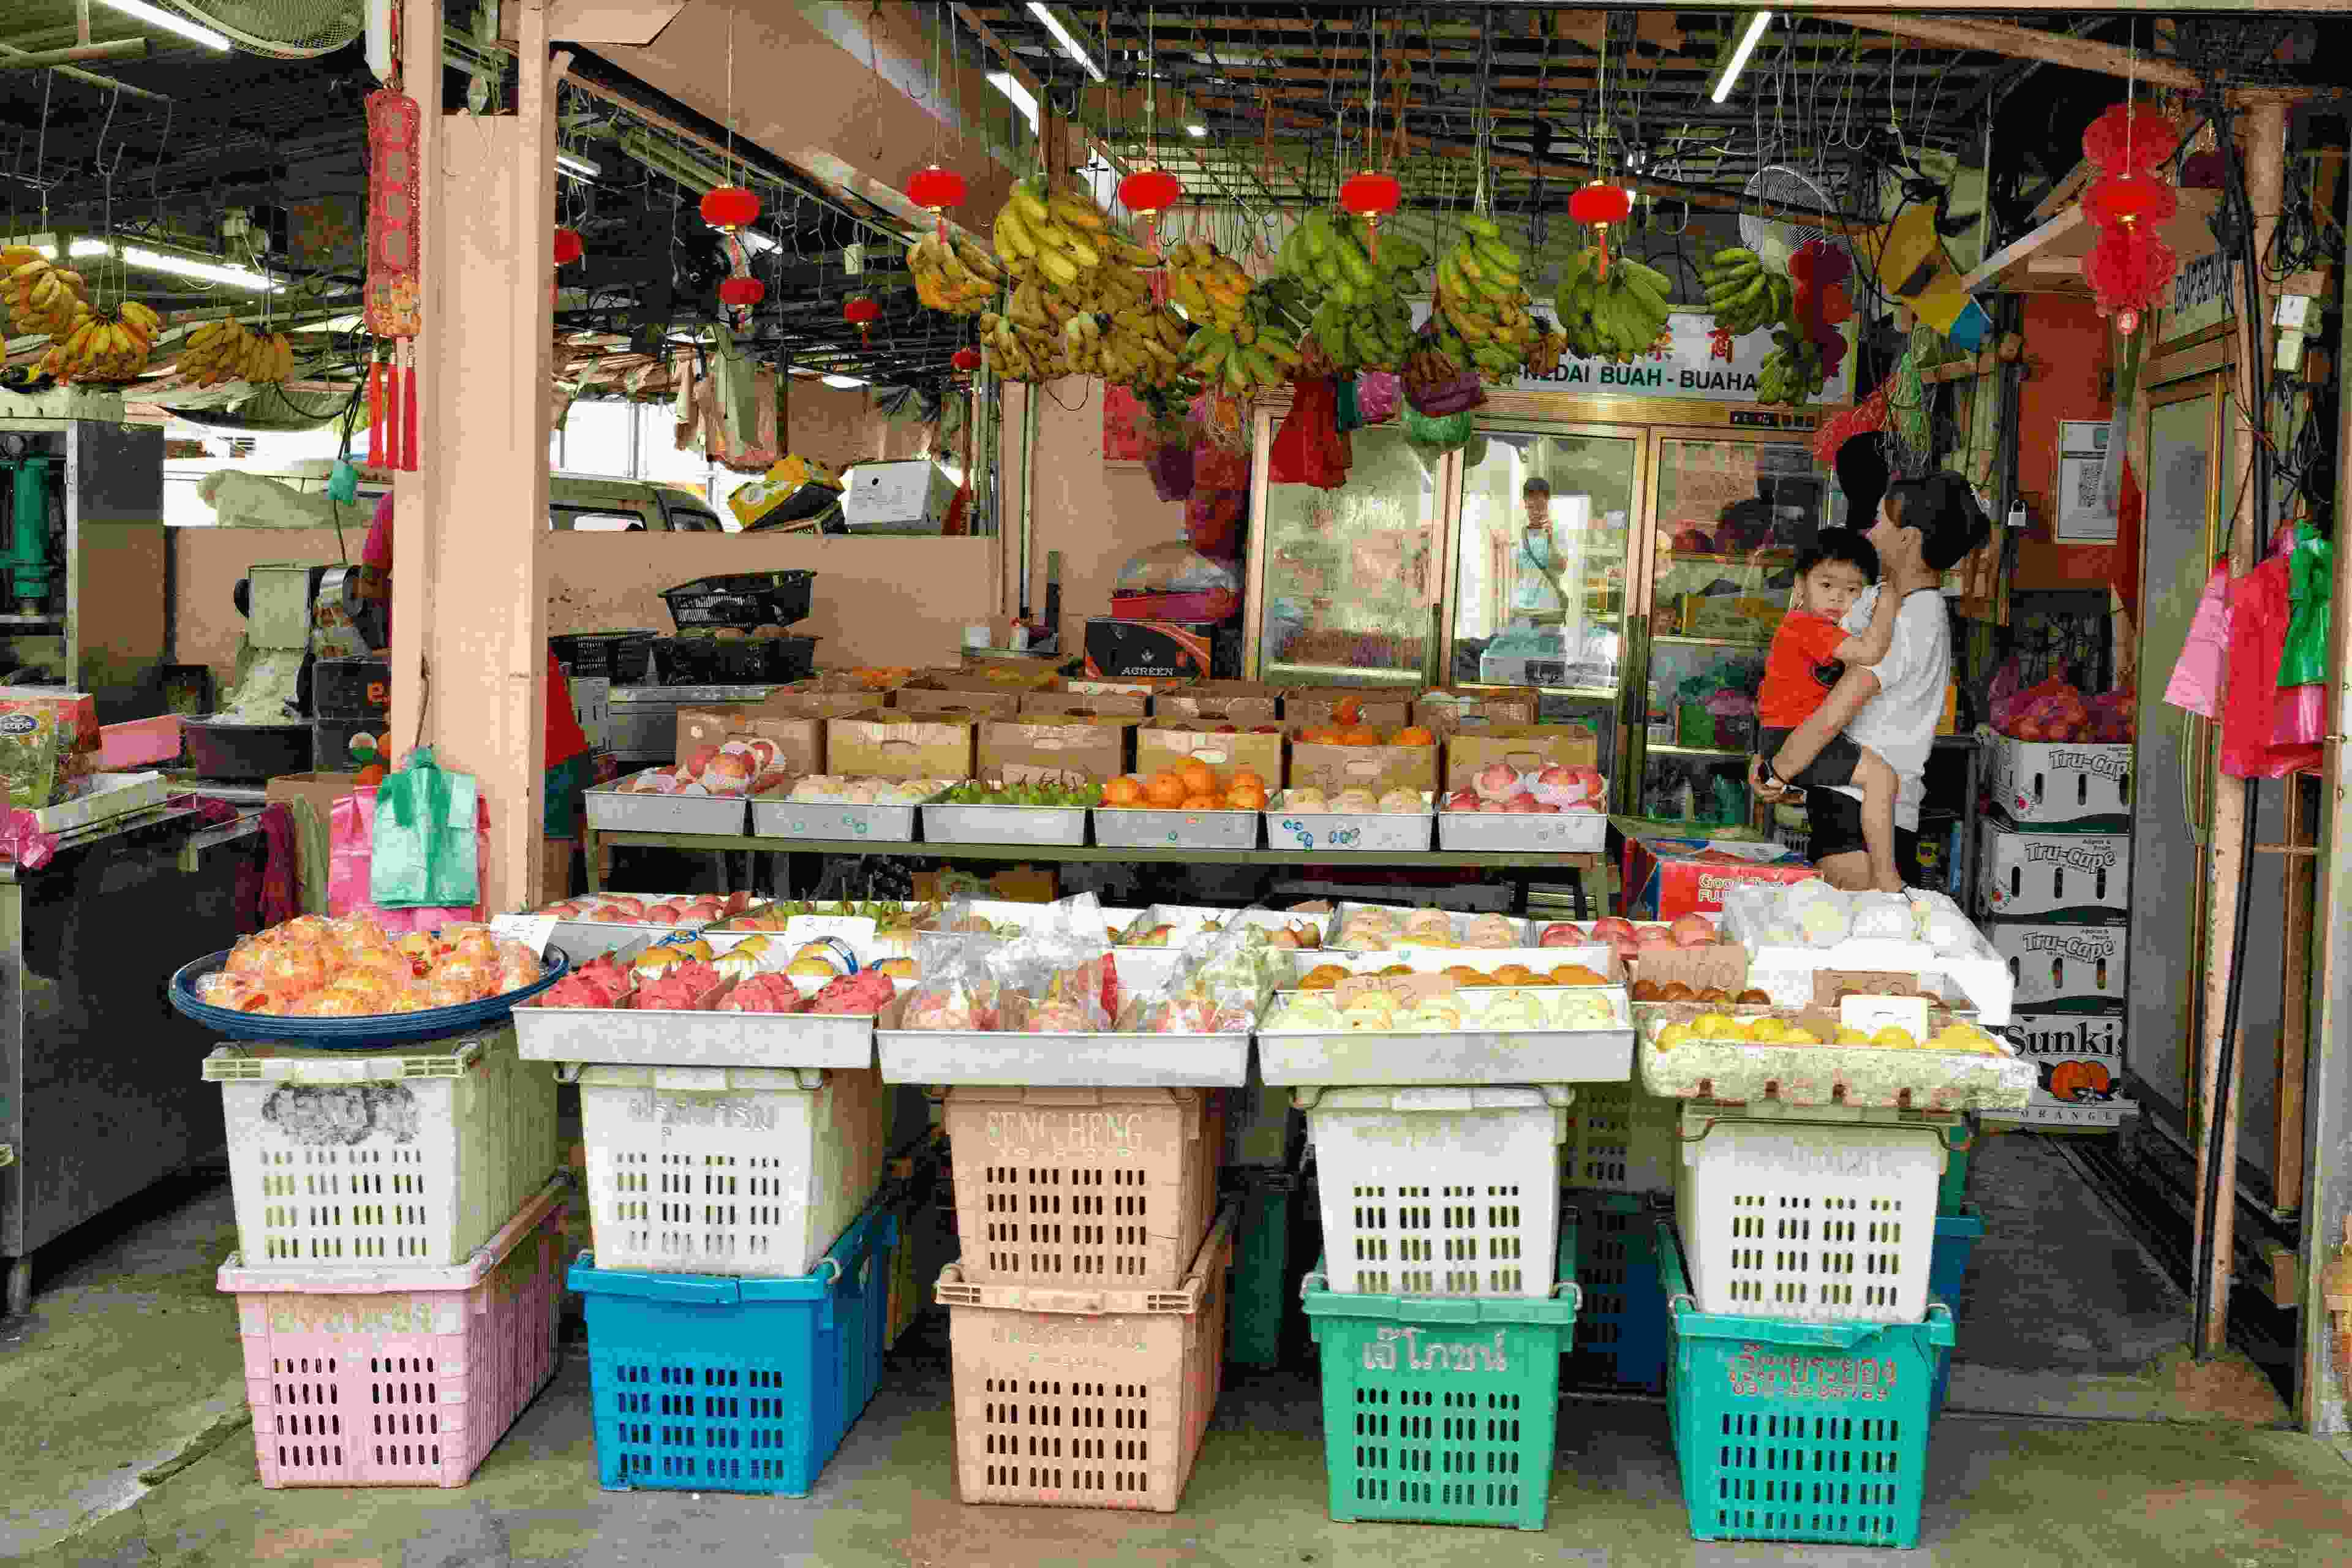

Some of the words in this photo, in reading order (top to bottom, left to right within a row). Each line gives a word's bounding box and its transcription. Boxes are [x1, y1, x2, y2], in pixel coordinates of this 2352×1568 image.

[1600, 366, 1662, 386] BUAH
[1121, 666, 1174, 676] AGREEN
[2024, 843, 2117, 875] Tru-Cape
[2022, 932, 2115, 964] Tru-Cape
